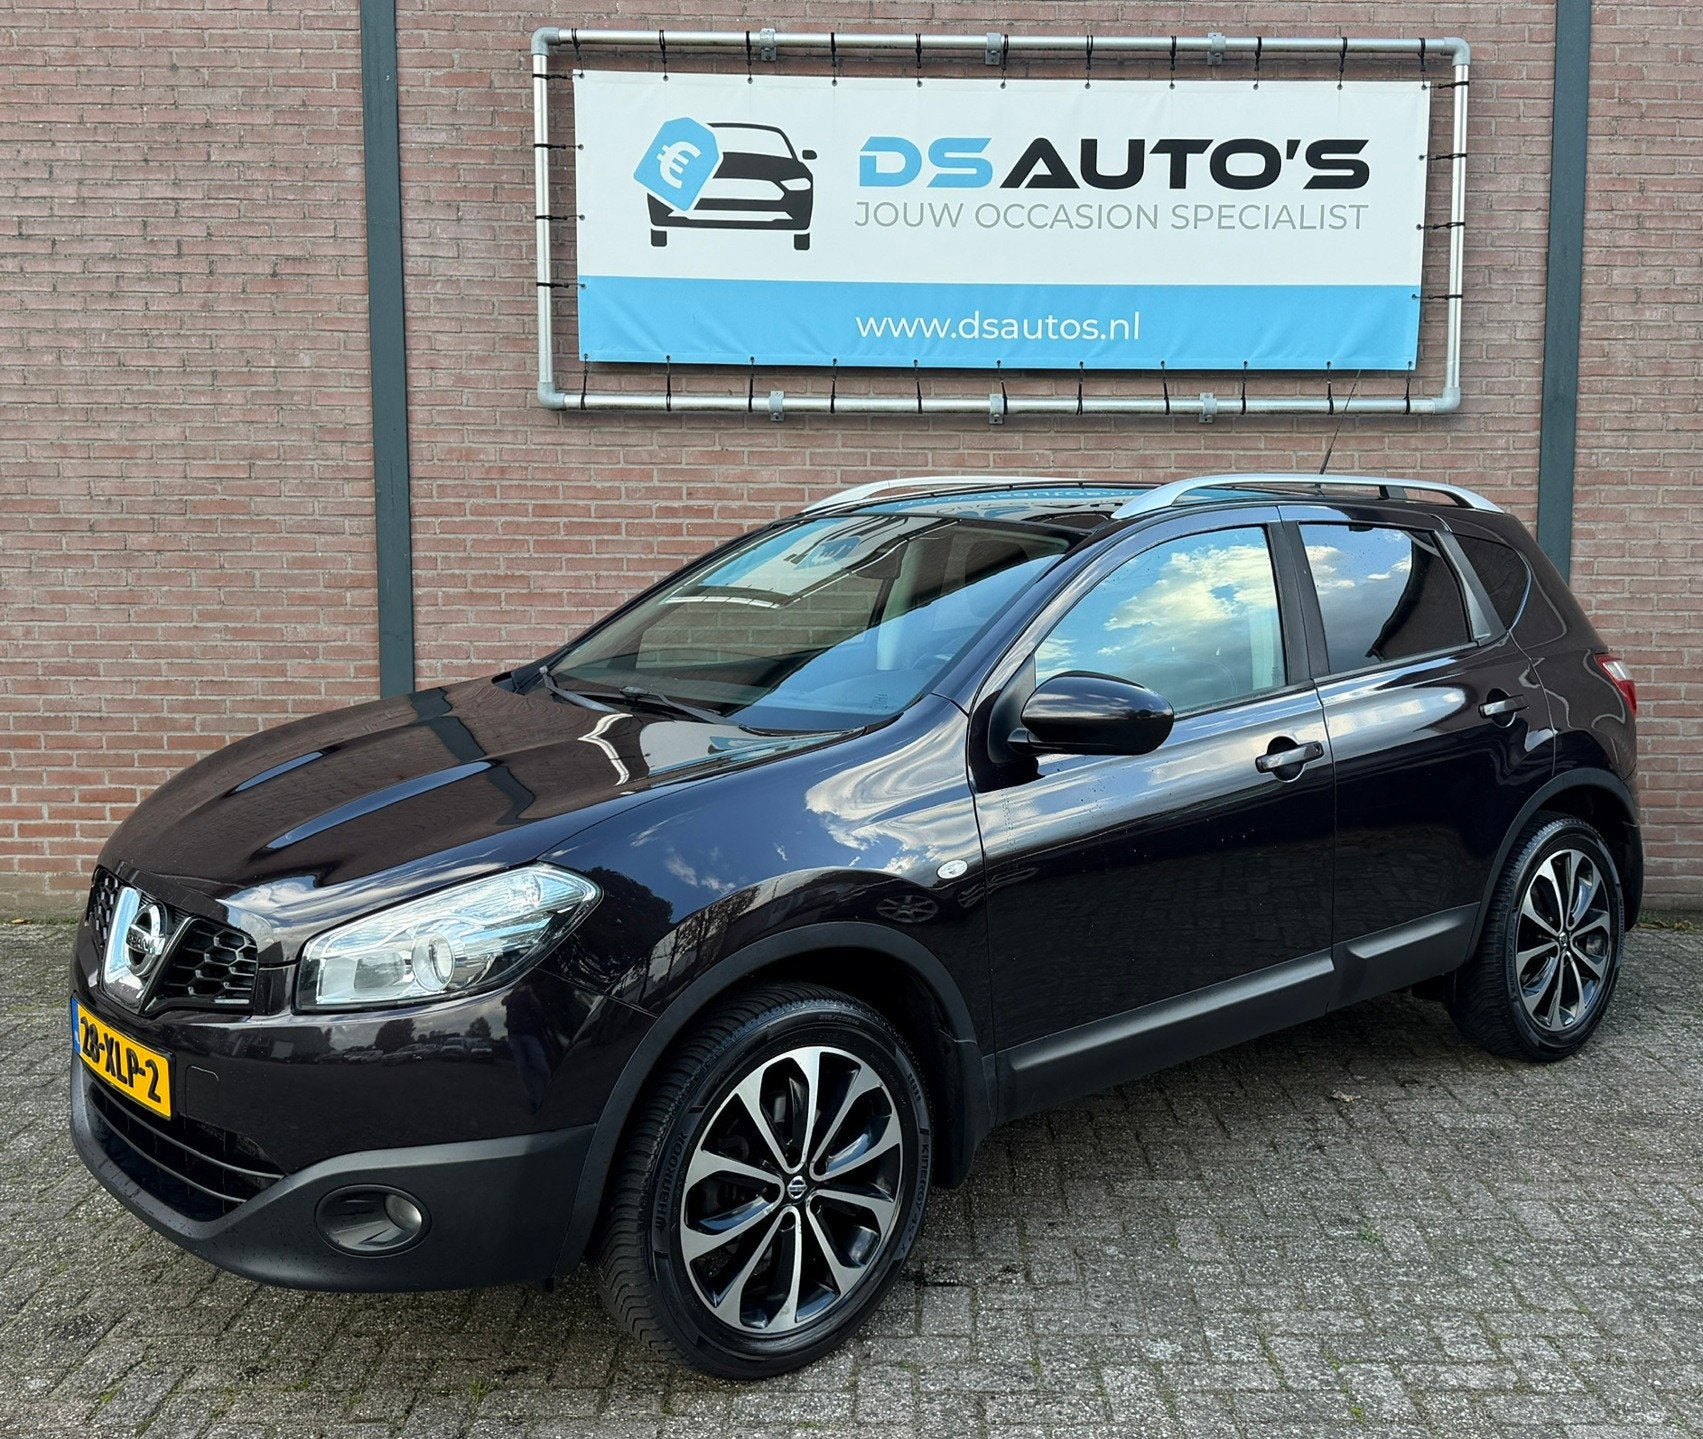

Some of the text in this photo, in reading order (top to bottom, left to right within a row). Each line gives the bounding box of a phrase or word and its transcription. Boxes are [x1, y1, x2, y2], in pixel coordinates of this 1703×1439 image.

[854, 201, 1369, 230] JOUW OCCASION SPECIALIST
[855, 310, 1140, 340] www.dsautos.nl
[80, 1016, 162, 1103] 28-XLP-2
